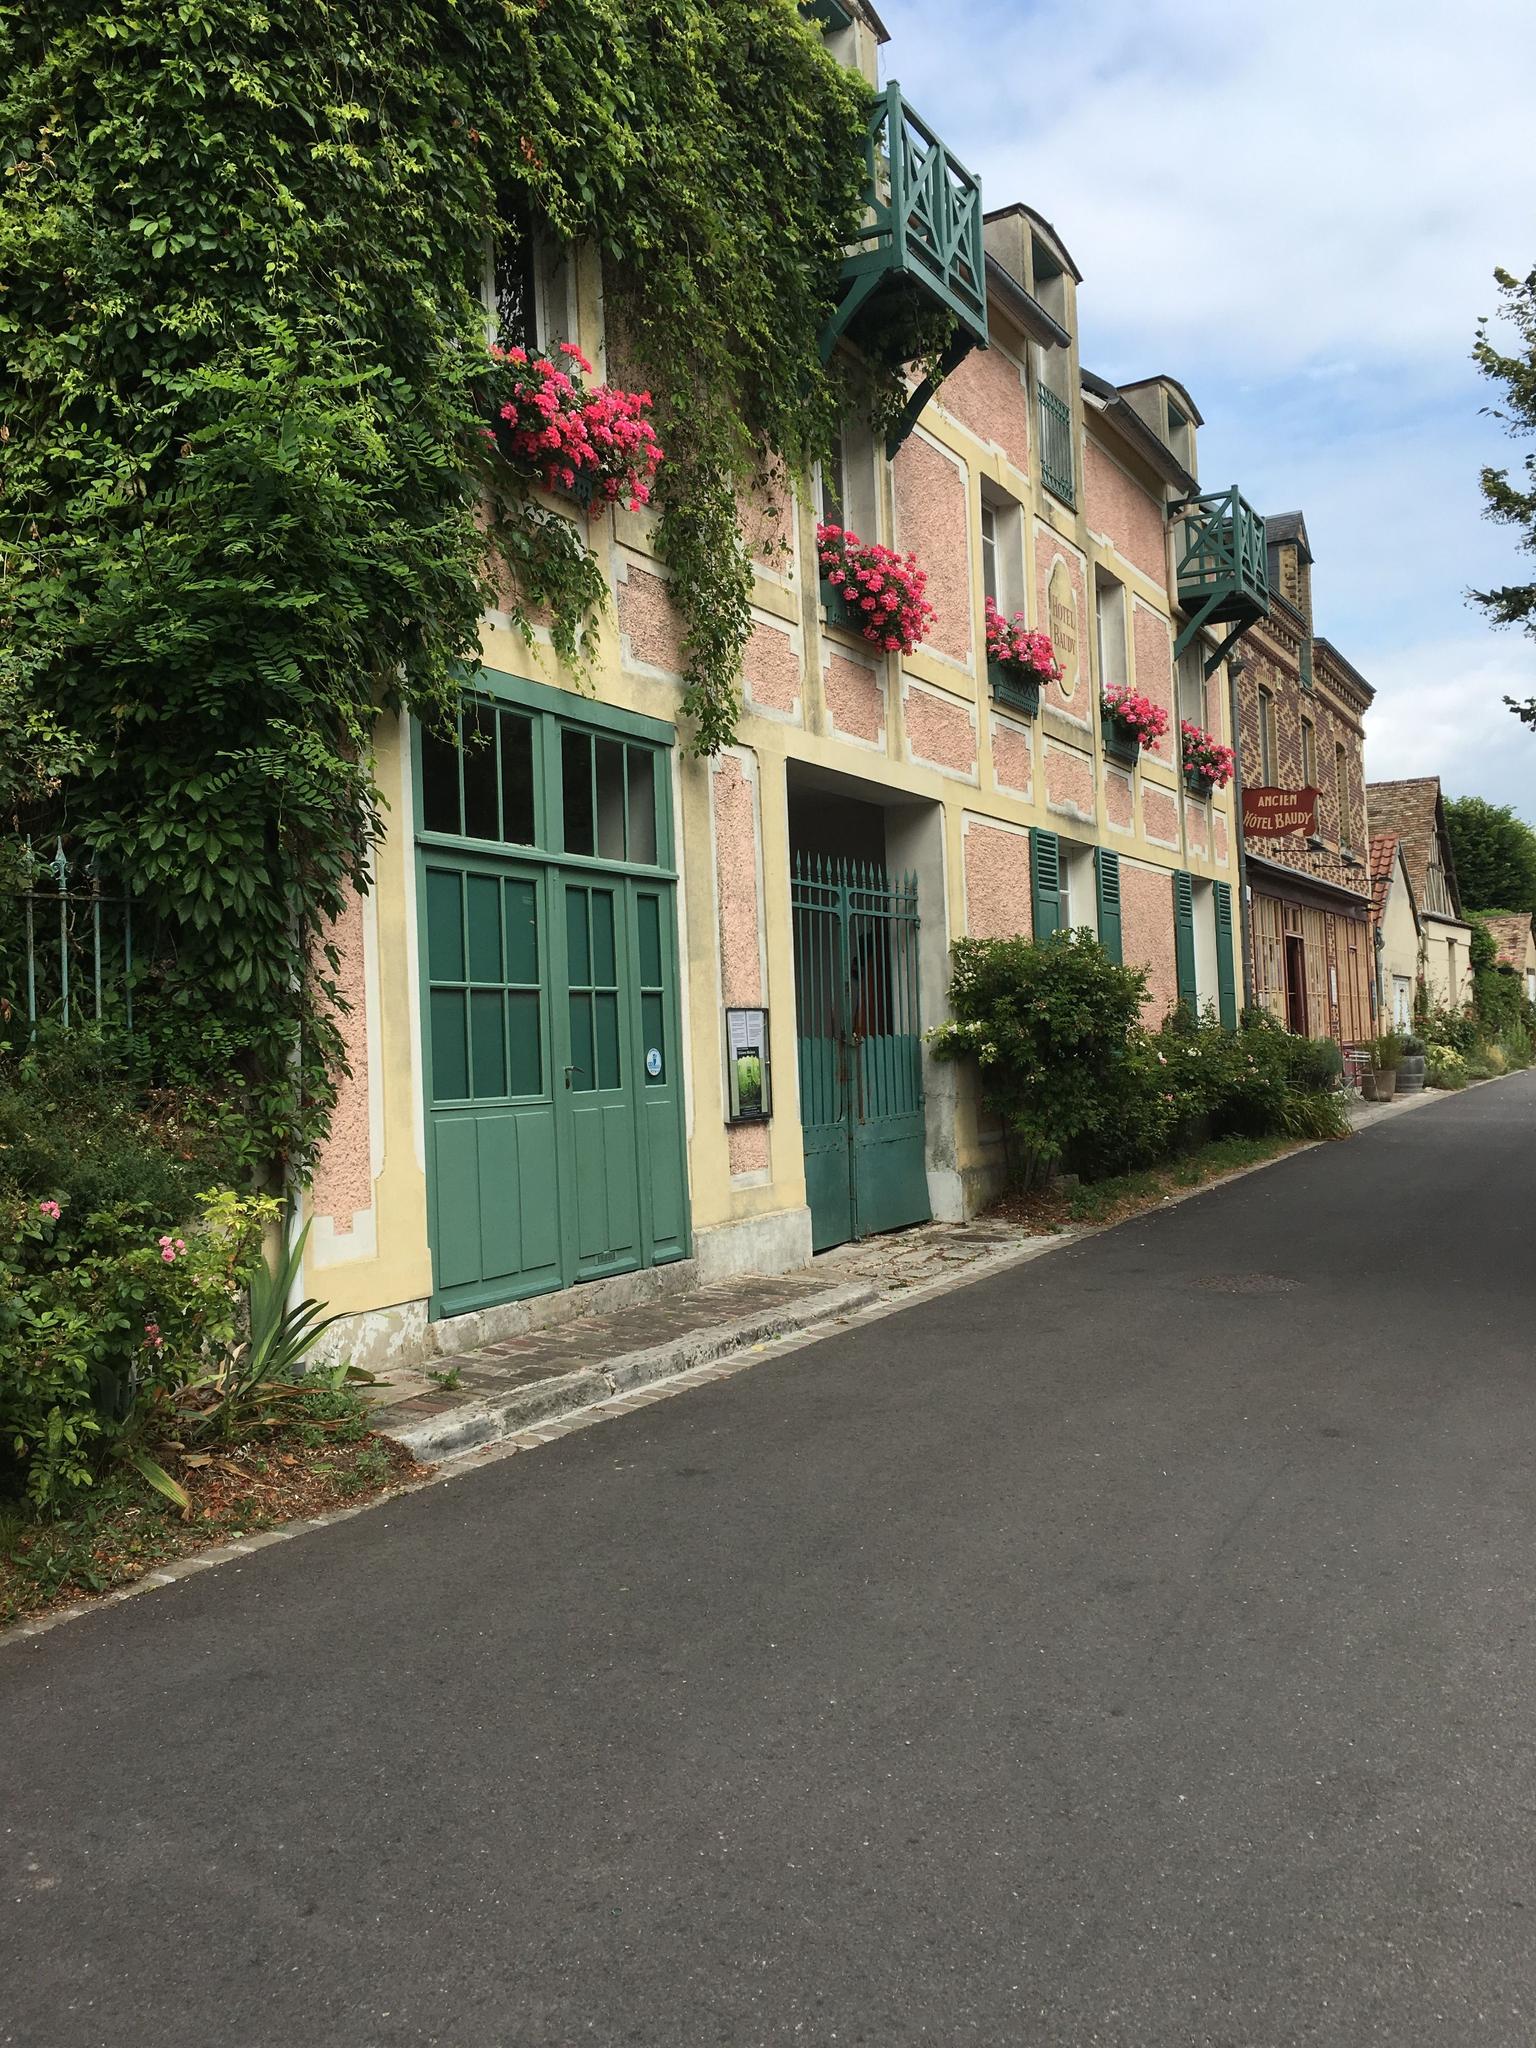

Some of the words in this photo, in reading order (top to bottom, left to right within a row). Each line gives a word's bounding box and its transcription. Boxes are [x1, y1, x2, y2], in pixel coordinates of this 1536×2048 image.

[1054, 623, 1076, 655] BAUDY
[1257, 794, 1297, 807] ANCIEN
[1274, 812, 1312, 830] BAUDY
